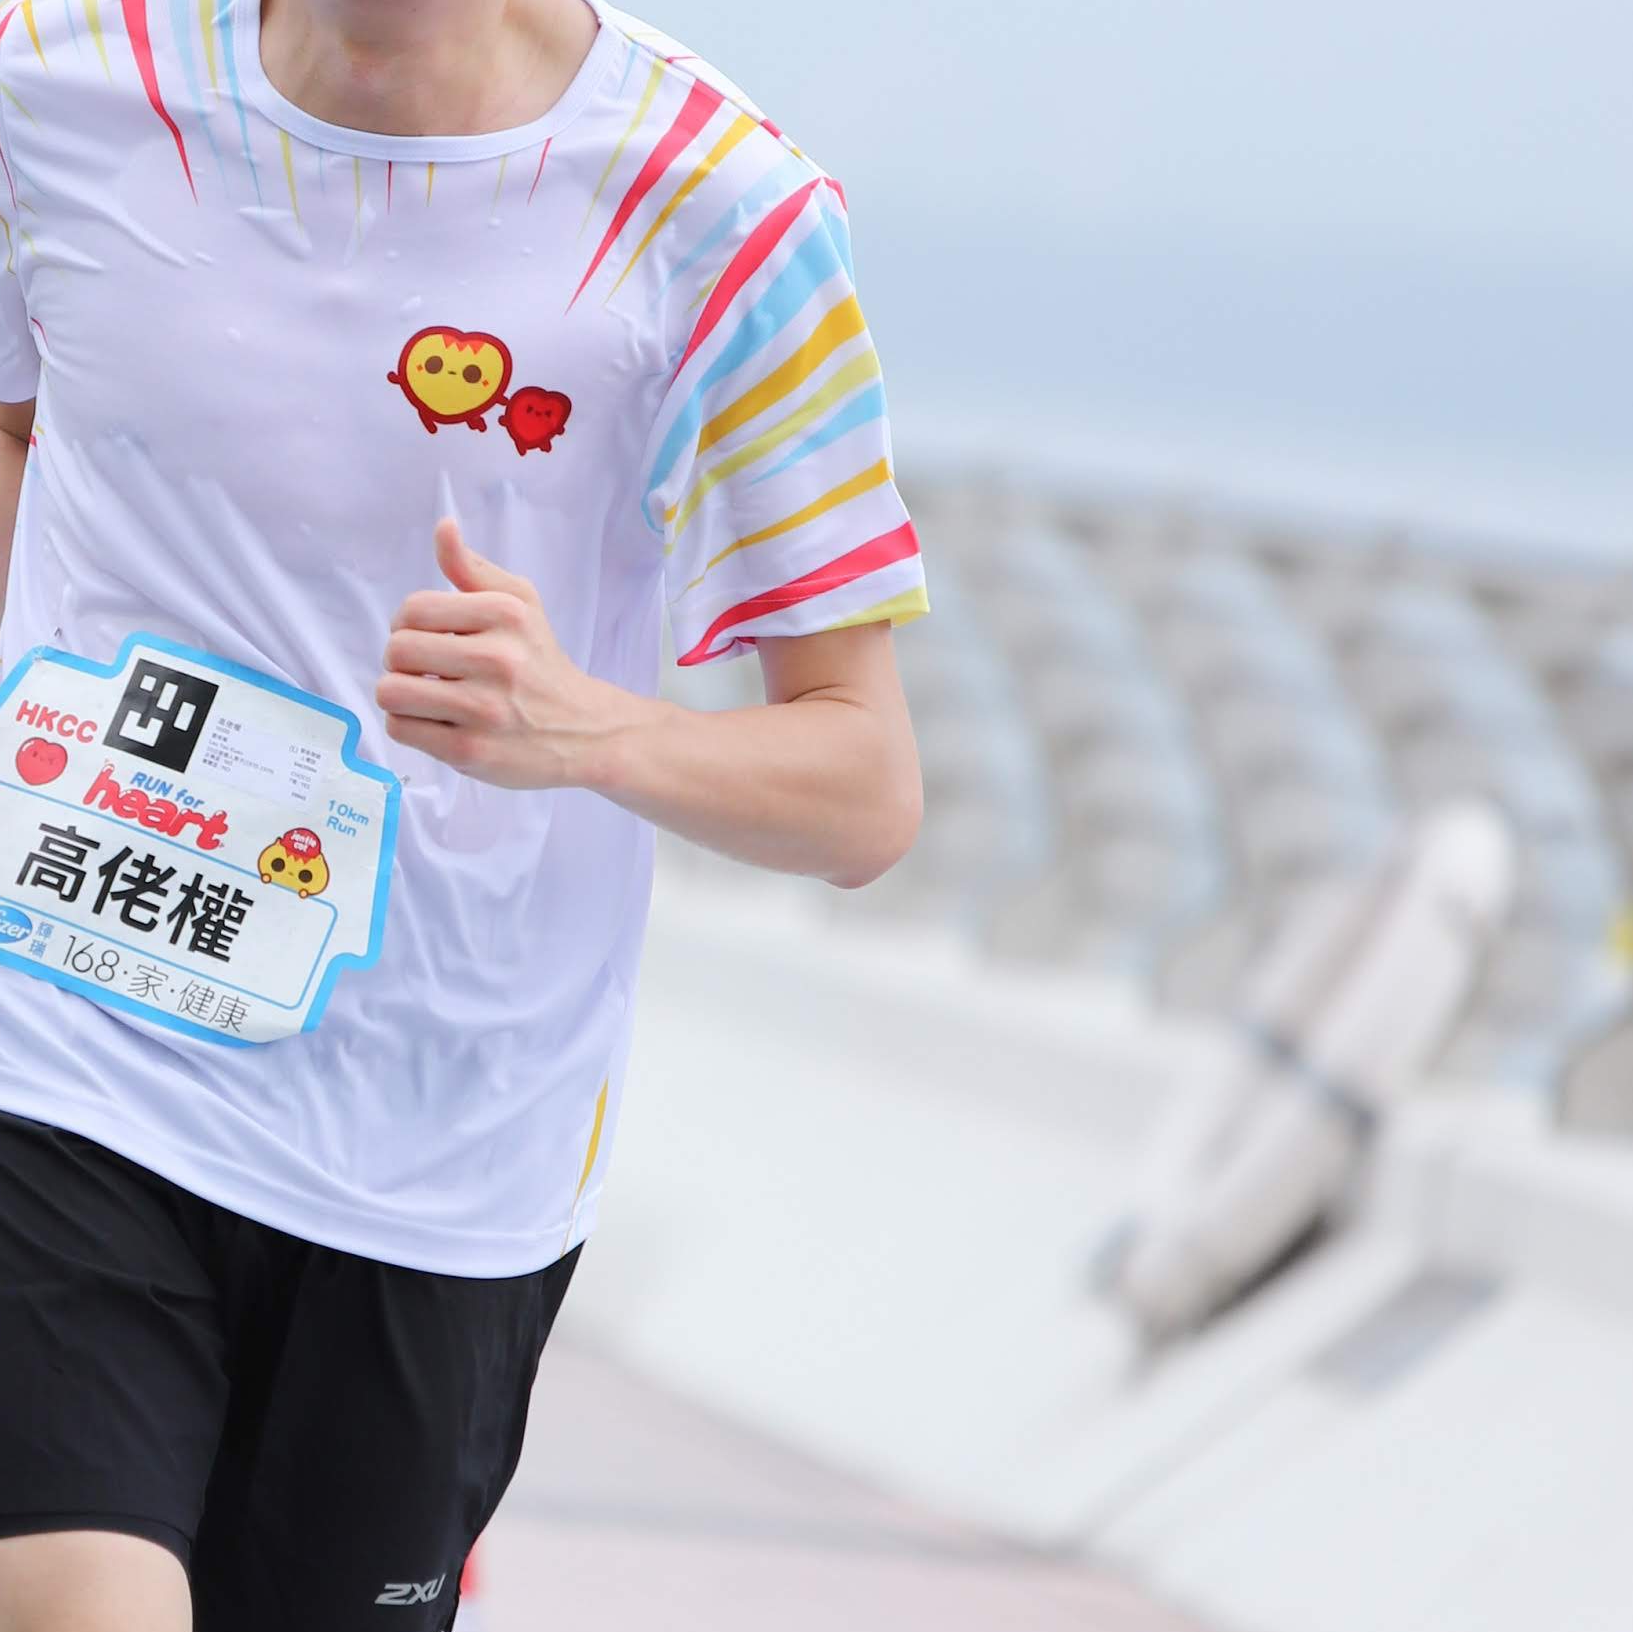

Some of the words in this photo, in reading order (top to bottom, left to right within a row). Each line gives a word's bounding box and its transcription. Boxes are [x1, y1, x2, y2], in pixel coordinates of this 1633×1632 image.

[16, 699, 98, 744] HKCC
[82, 763, 230, 851] heart
[130, 771, 175, 798] RUN
[176, 788, 205, 810] for
[326, 815, 357, 838] Run
[328, 799, 369, 826] 10km
[15, 821, 255, 964] 高佬權
[374, 1573, 446, 1606] 2XU
